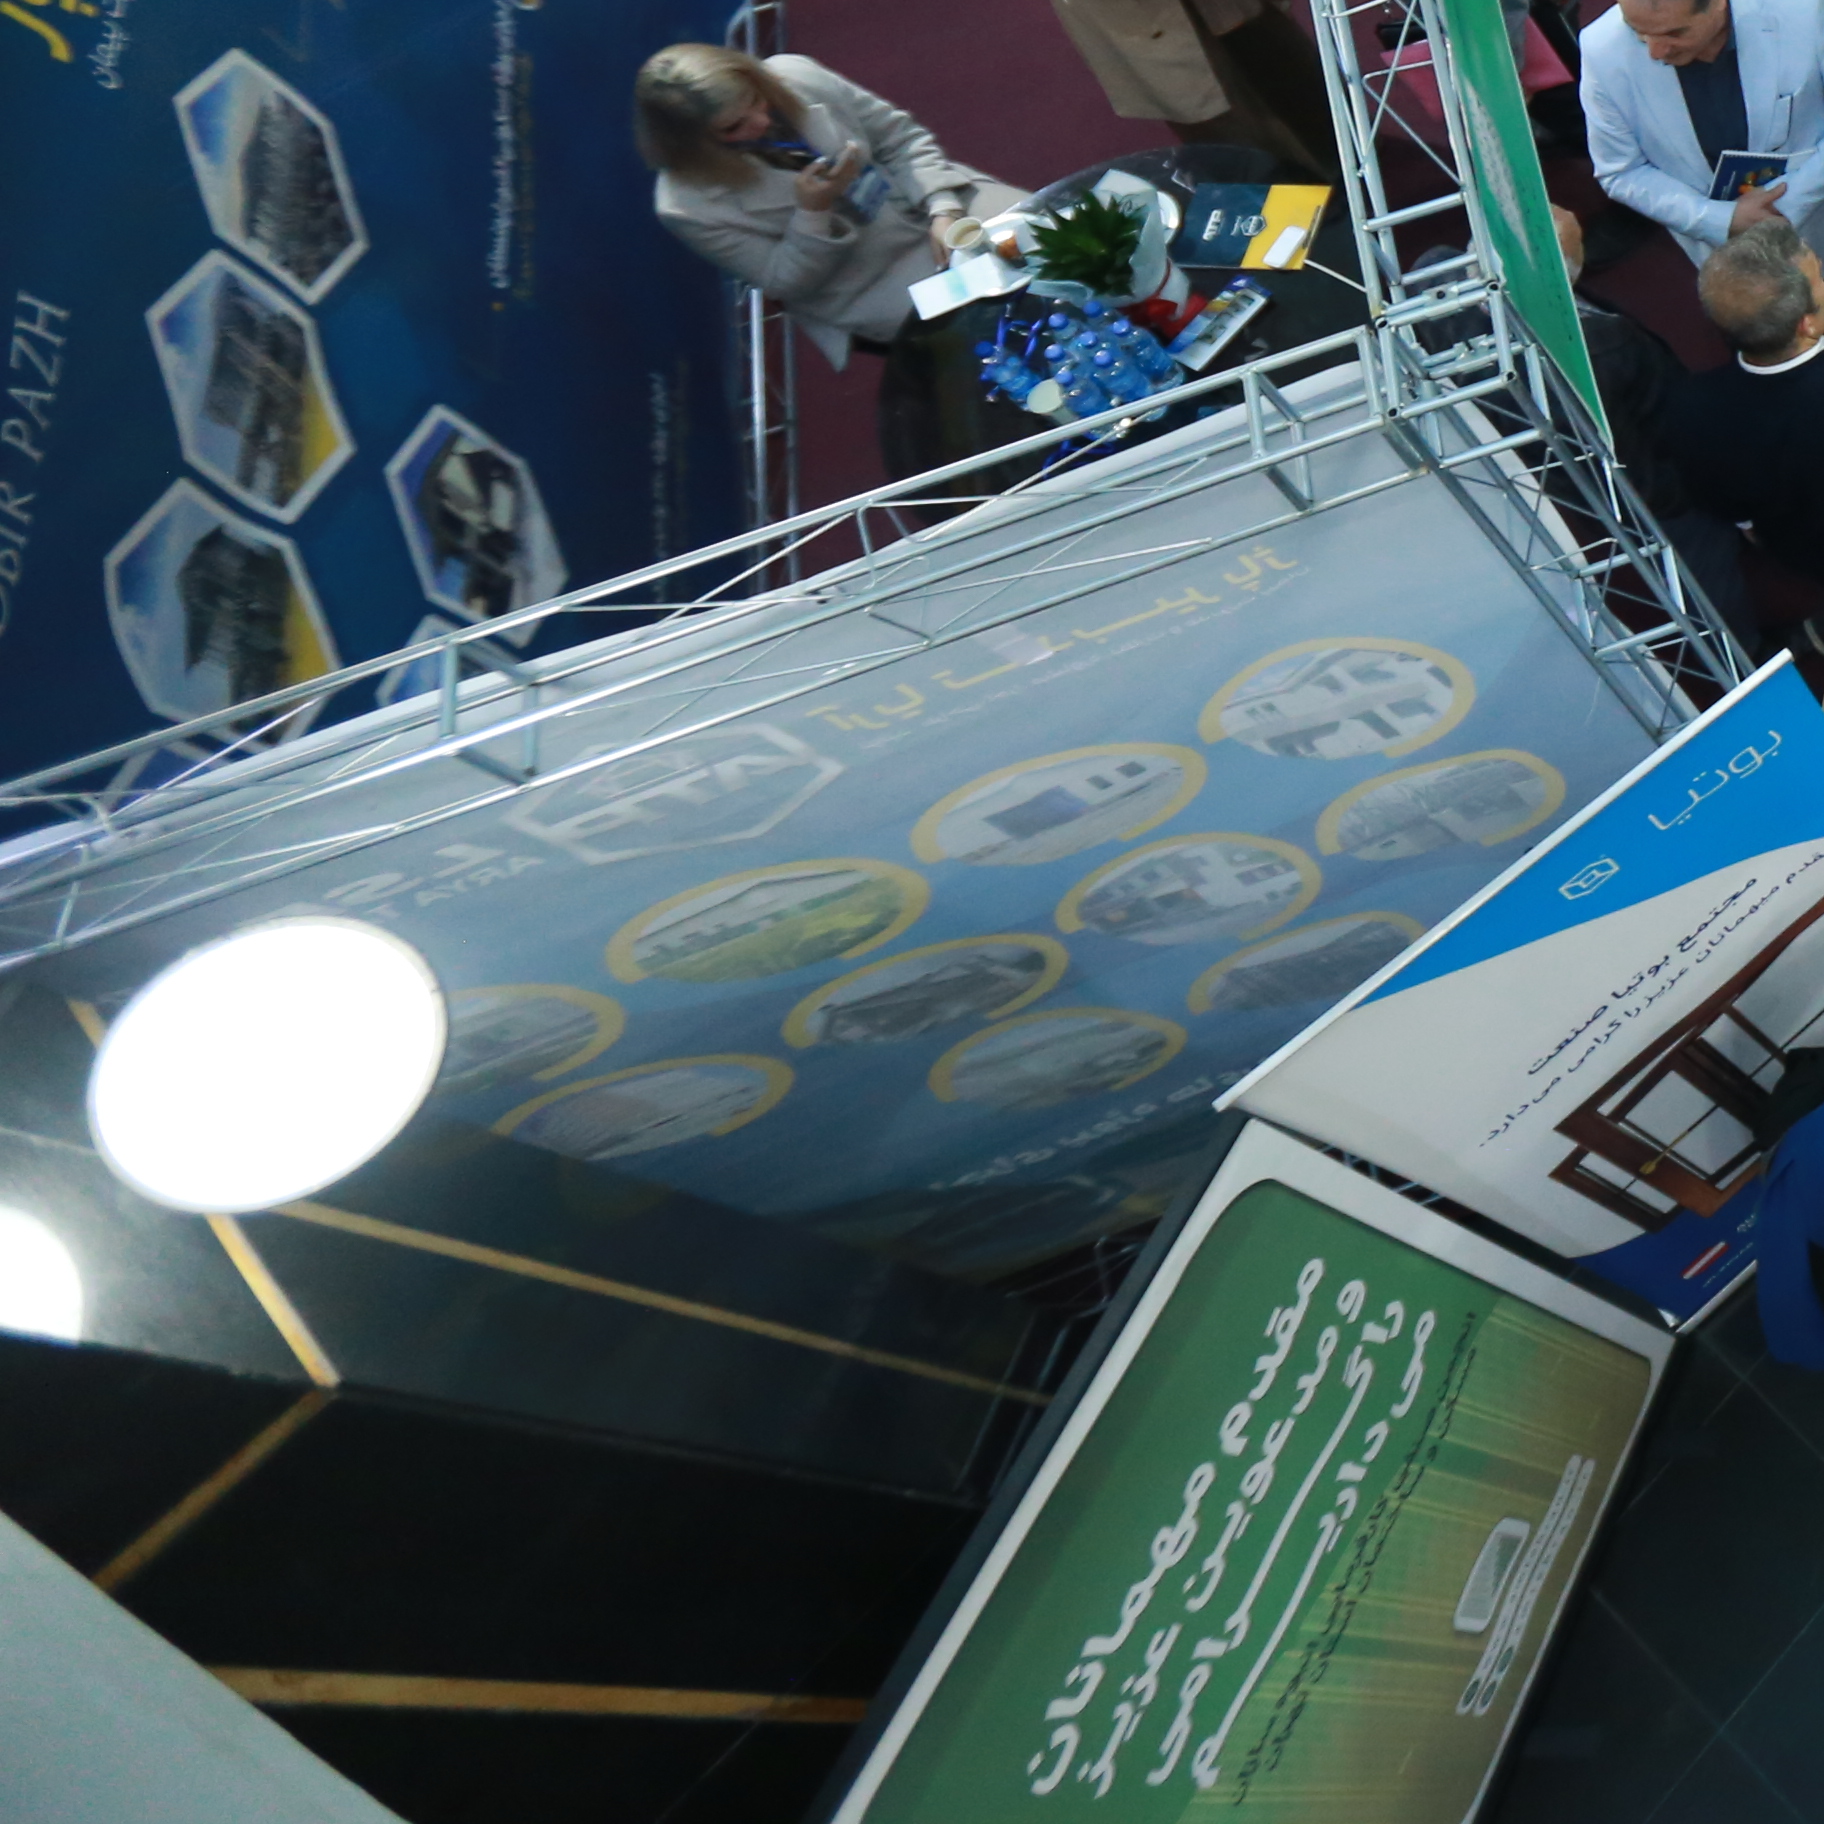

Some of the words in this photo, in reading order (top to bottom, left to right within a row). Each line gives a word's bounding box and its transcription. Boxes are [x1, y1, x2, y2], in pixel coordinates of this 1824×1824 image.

[4, 290, 71, 463] PAZH
[1647, 728, 1783, 833] بوتیا
[1676, 876, 1758, 954] مجتمع
[1610, 954, 1670, 1000] بوتیا
[1646, 966, 1690, 1009] عزیز
[1526, 1004, 1609, 1076] صنعت
[1567, 1018, 1622, 1073] گرامی
[1337, 1279, 1367, 1318] و
[1361, 1300, 1404, 1345] را
[1220, 1257, 1324, 1455] مقدم
[1185, 1326, 1338, 1613] مدعوین
[1148, 1342, 1375, 1786] گرامی
[1027, 1461, 1215, 1797] مهمانان
[1077, 1621, 1183, 1798] عزیز
